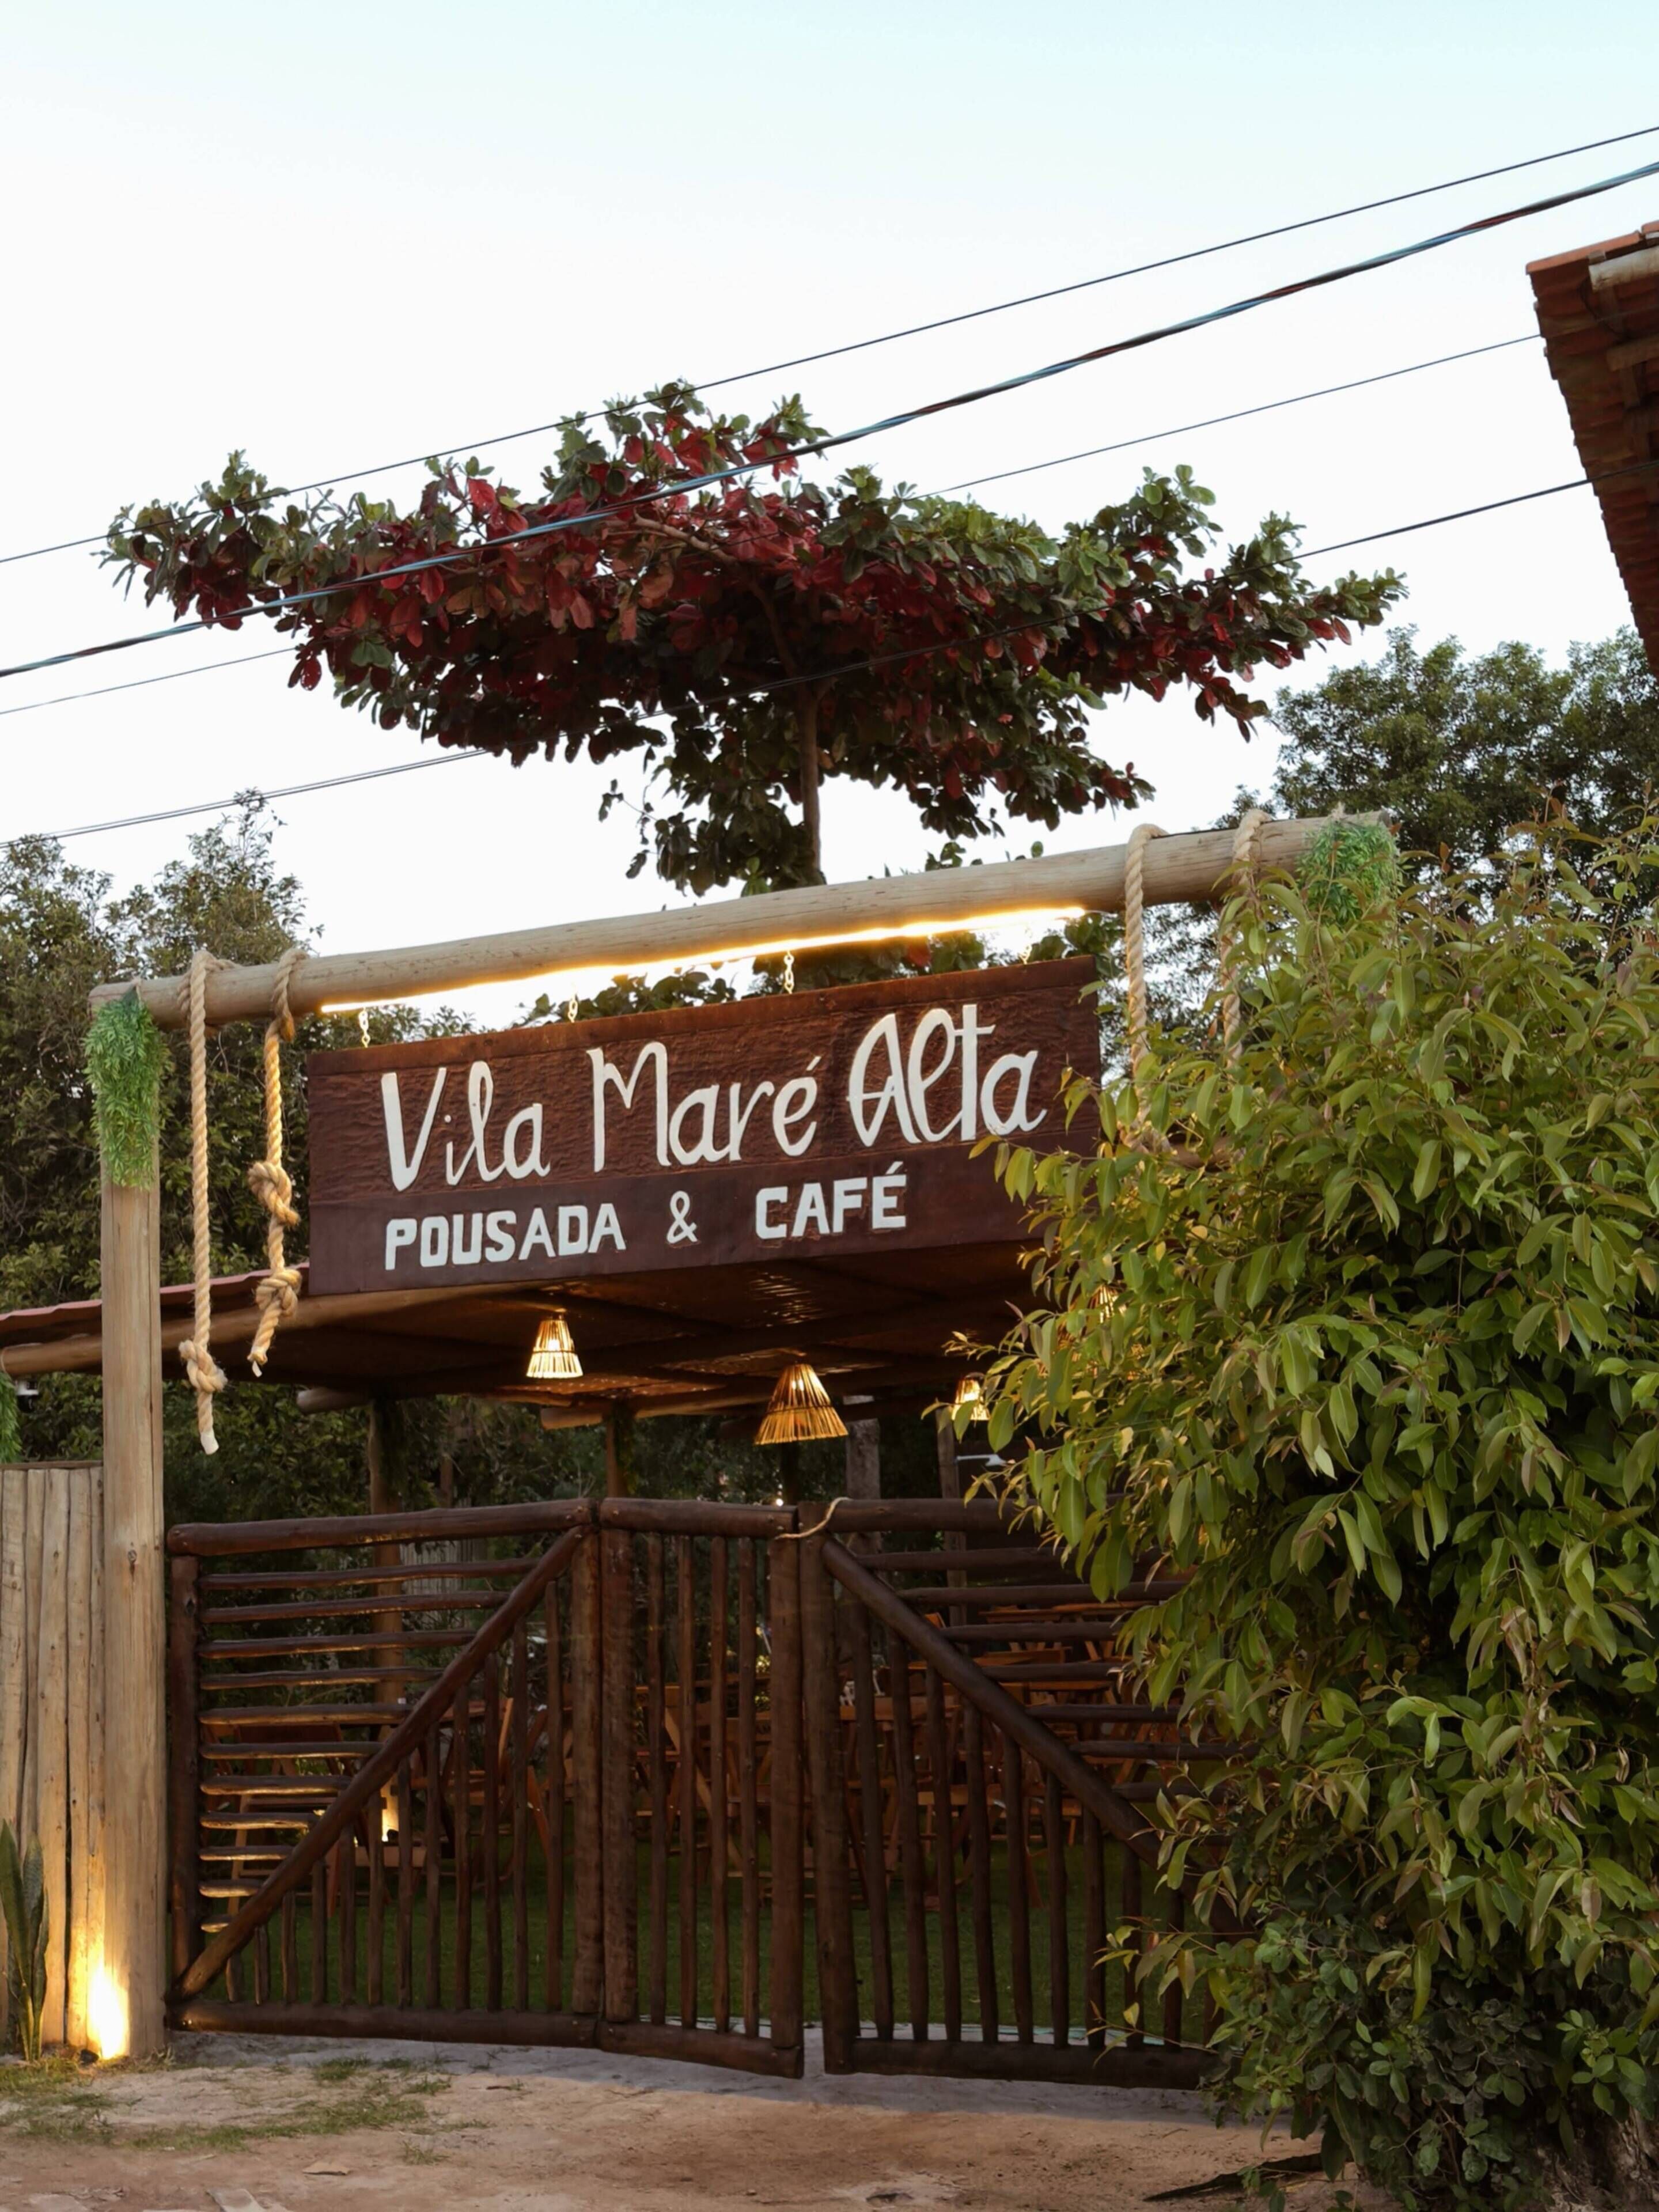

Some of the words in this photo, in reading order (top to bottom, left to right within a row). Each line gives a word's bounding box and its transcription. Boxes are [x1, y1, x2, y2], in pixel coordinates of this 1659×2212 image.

[380, 1060, 551, 1192] Vila
[586, 1041, 820, 1173] Maré
[846, 1003, 1047, 1147] Alta
[385, 1203, 627, 1271] POUSADA
[666, 1190, 698, 1244] &
[755, 1160, 907, 1240] CAFÉ
